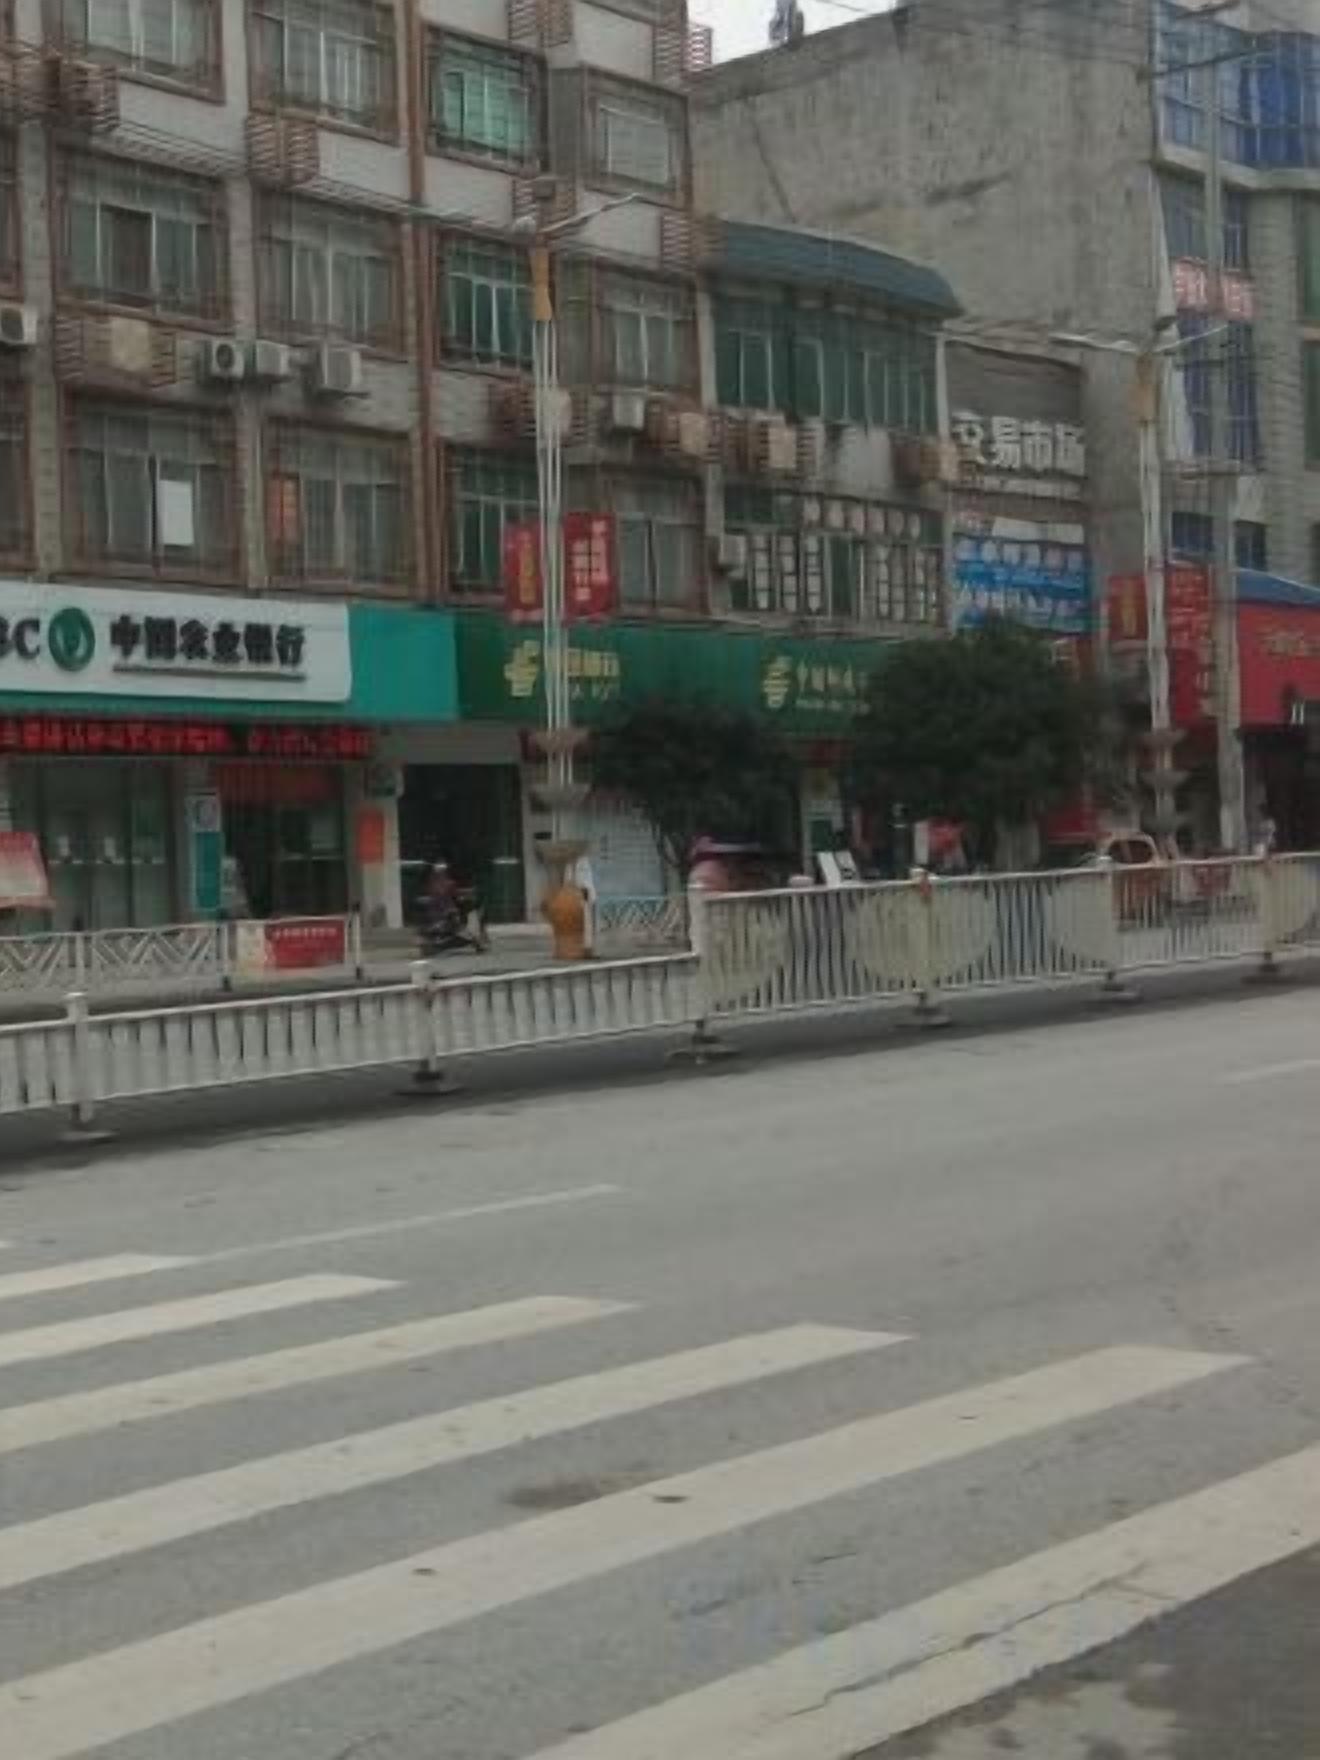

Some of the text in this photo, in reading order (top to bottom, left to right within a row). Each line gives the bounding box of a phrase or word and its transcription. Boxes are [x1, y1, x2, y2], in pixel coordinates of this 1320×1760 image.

[110, 614, 305, 666] 中国农业银行
